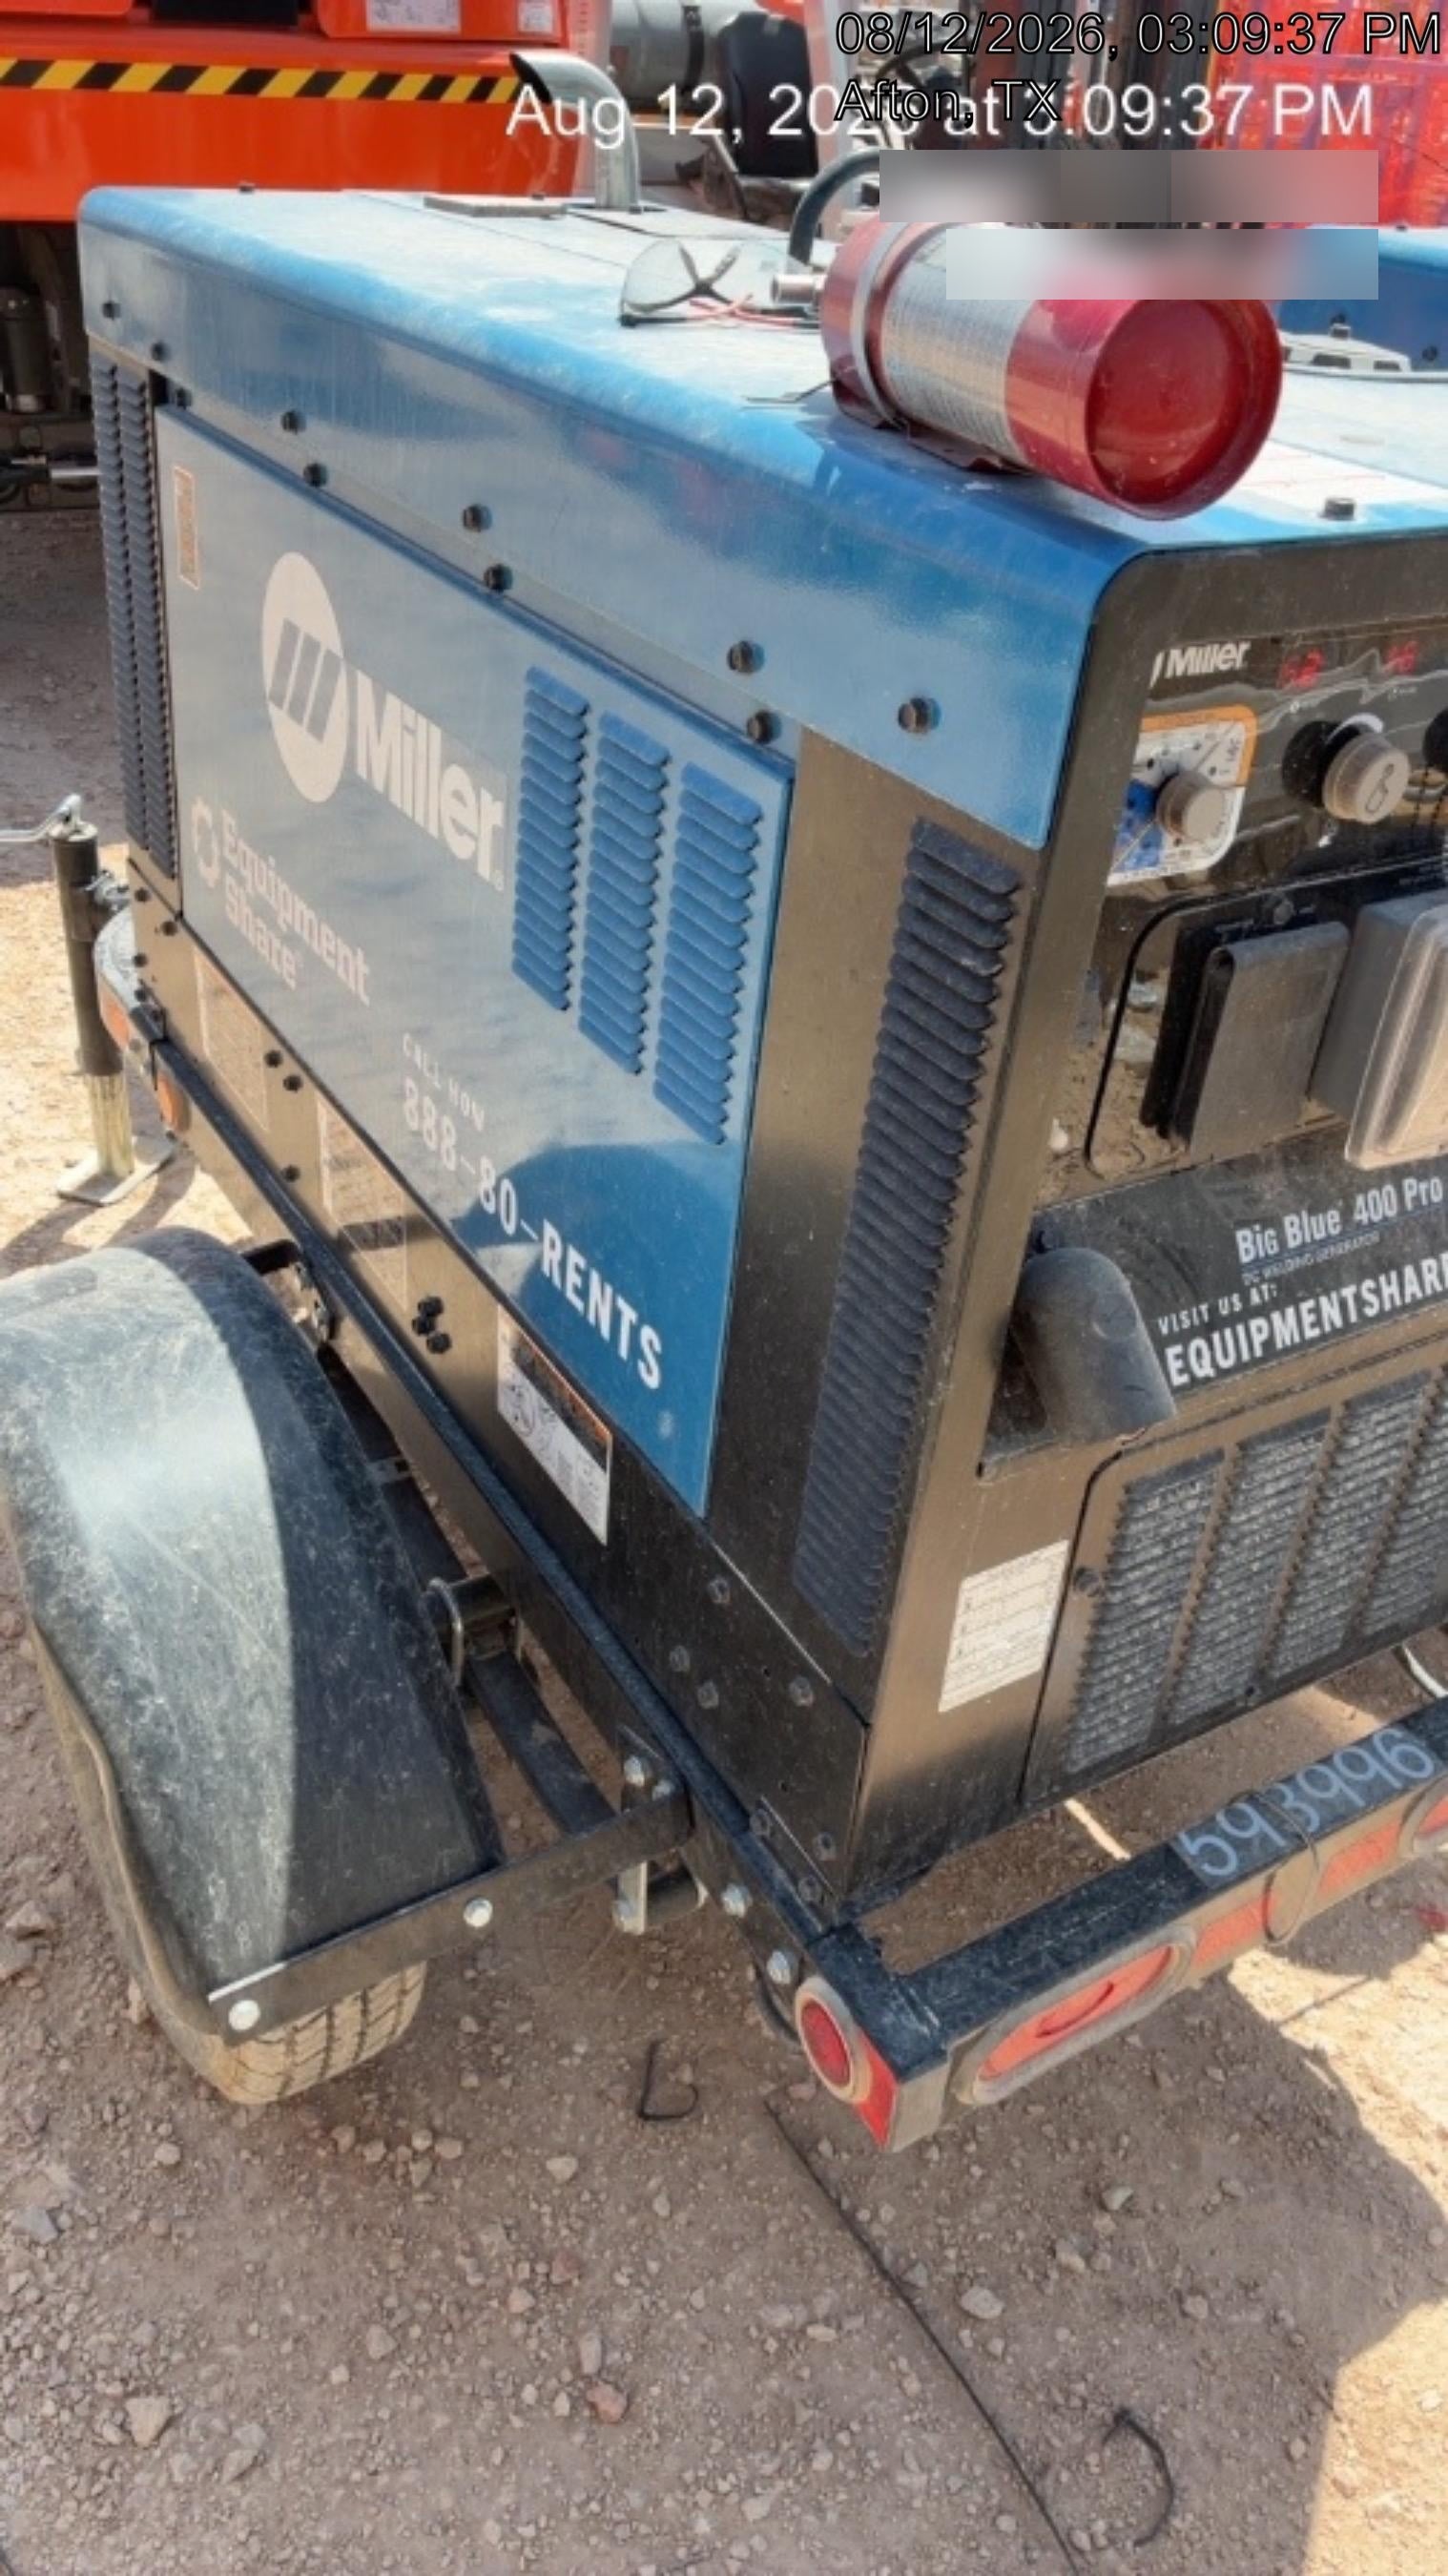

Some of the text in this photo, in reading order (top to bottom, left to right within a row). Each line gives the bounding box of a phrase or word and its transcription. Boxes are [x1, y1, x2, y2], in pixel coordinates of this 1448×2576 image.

[1165, 640, 1251, 679] Miller
[356, 668, 505, 883] Miller
[221, 808, 370, 1008] Equipment
[225, 873, 297, 990] Share
[1283, 1209, 1343, 1249] Blue
[1353, 1184, 1397, 1225] 400
[1401, 1175, 1444, 1212] Pro
[1157, 1283, 1277, 1337] VISIT US AT:
[1177, 1727, 1435, 1877] 593996
